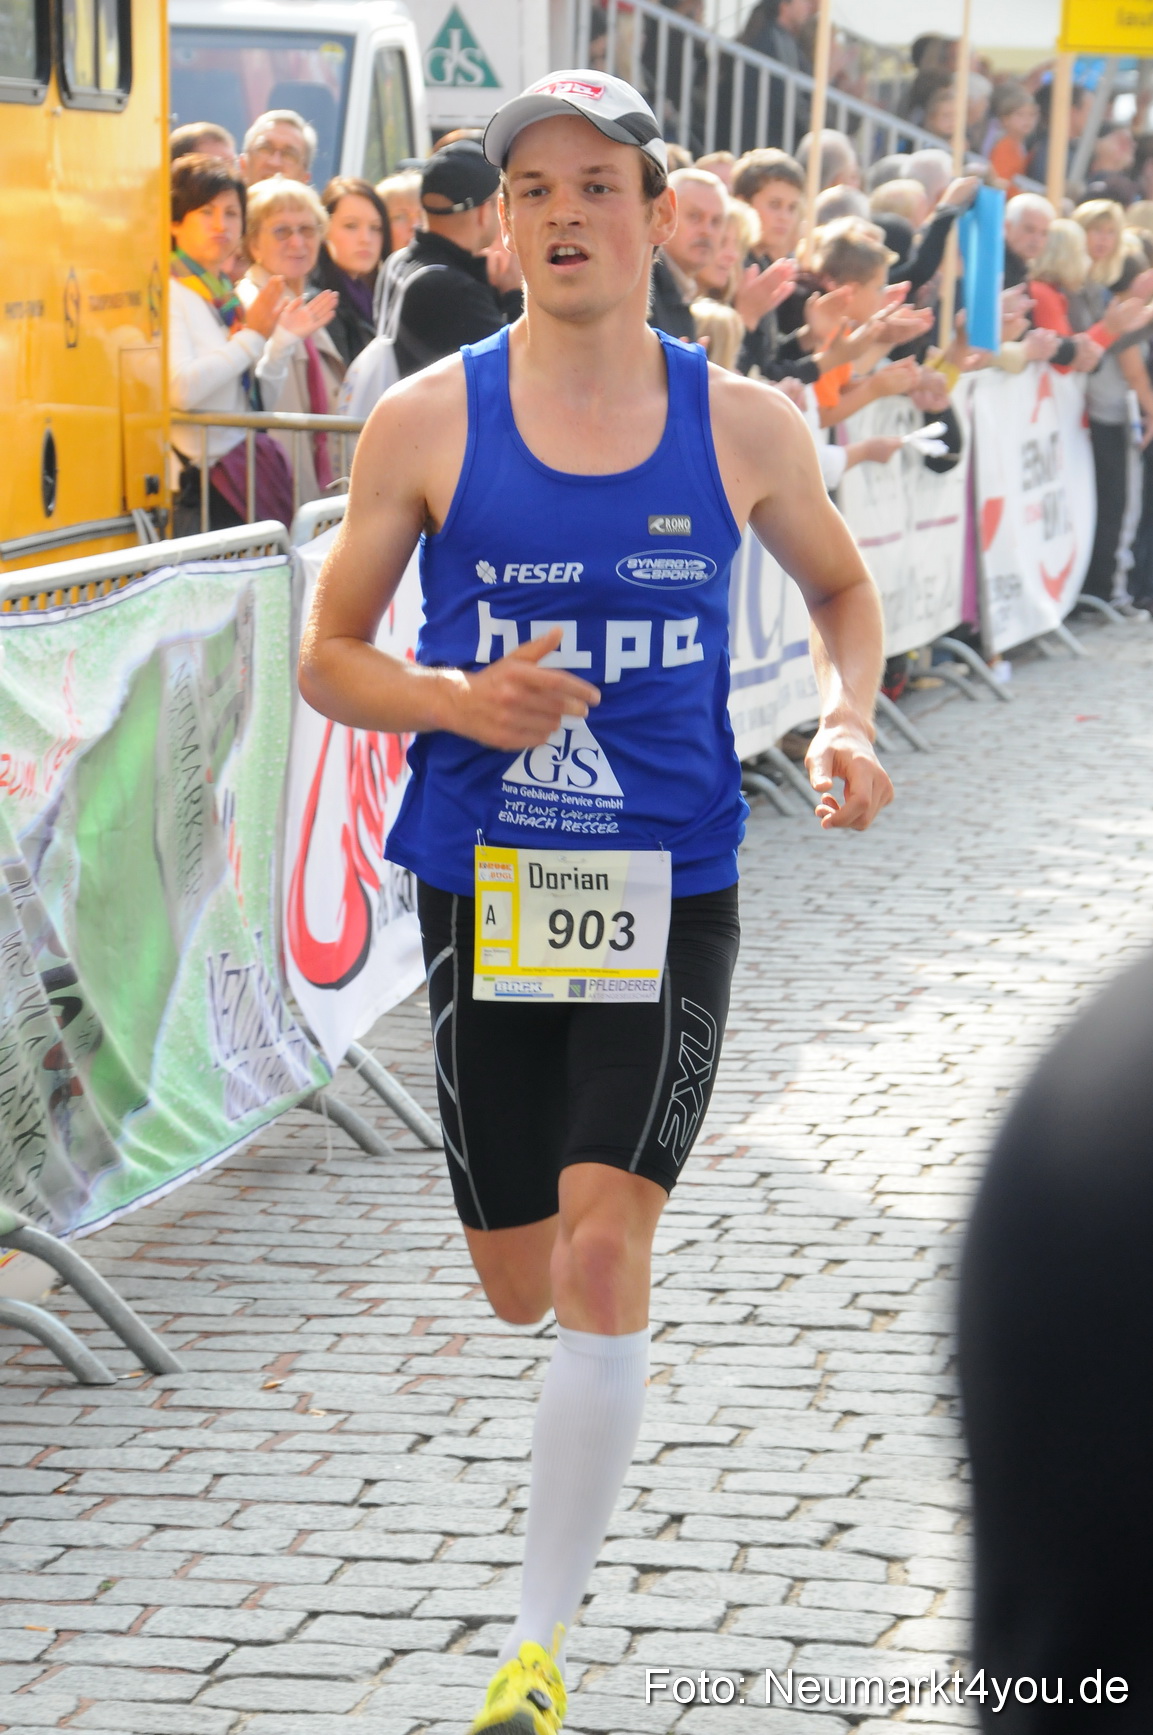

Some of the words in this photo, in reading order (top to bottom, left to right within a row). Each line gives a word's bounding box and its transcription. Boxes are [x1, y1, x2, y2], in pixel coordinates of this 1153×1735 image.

[503, 562, 584, 584] FESER
[627, 558, 707, 571] SYNERGY
[650, 569, 705, 581] SPORTS
[501, 781, 518, 796] Jura
[520, 786, 560, 803] Gebäude
[561, 793, 593, 808] Service
[595, 798, 623, 810] GmbH
[528, 803, 558, 817] UNS
[498, 810, 557, 830] EINFACH
[561, 819, 620, 835] BESSER
[528, 862, 609, 891] Dorian
[485, 904, 497, 926] A
[548, 909, 635, 951] 903
[588, 978, 657, 992] PFLEIDERER
[658, 997, 717, 1167] 2XU
